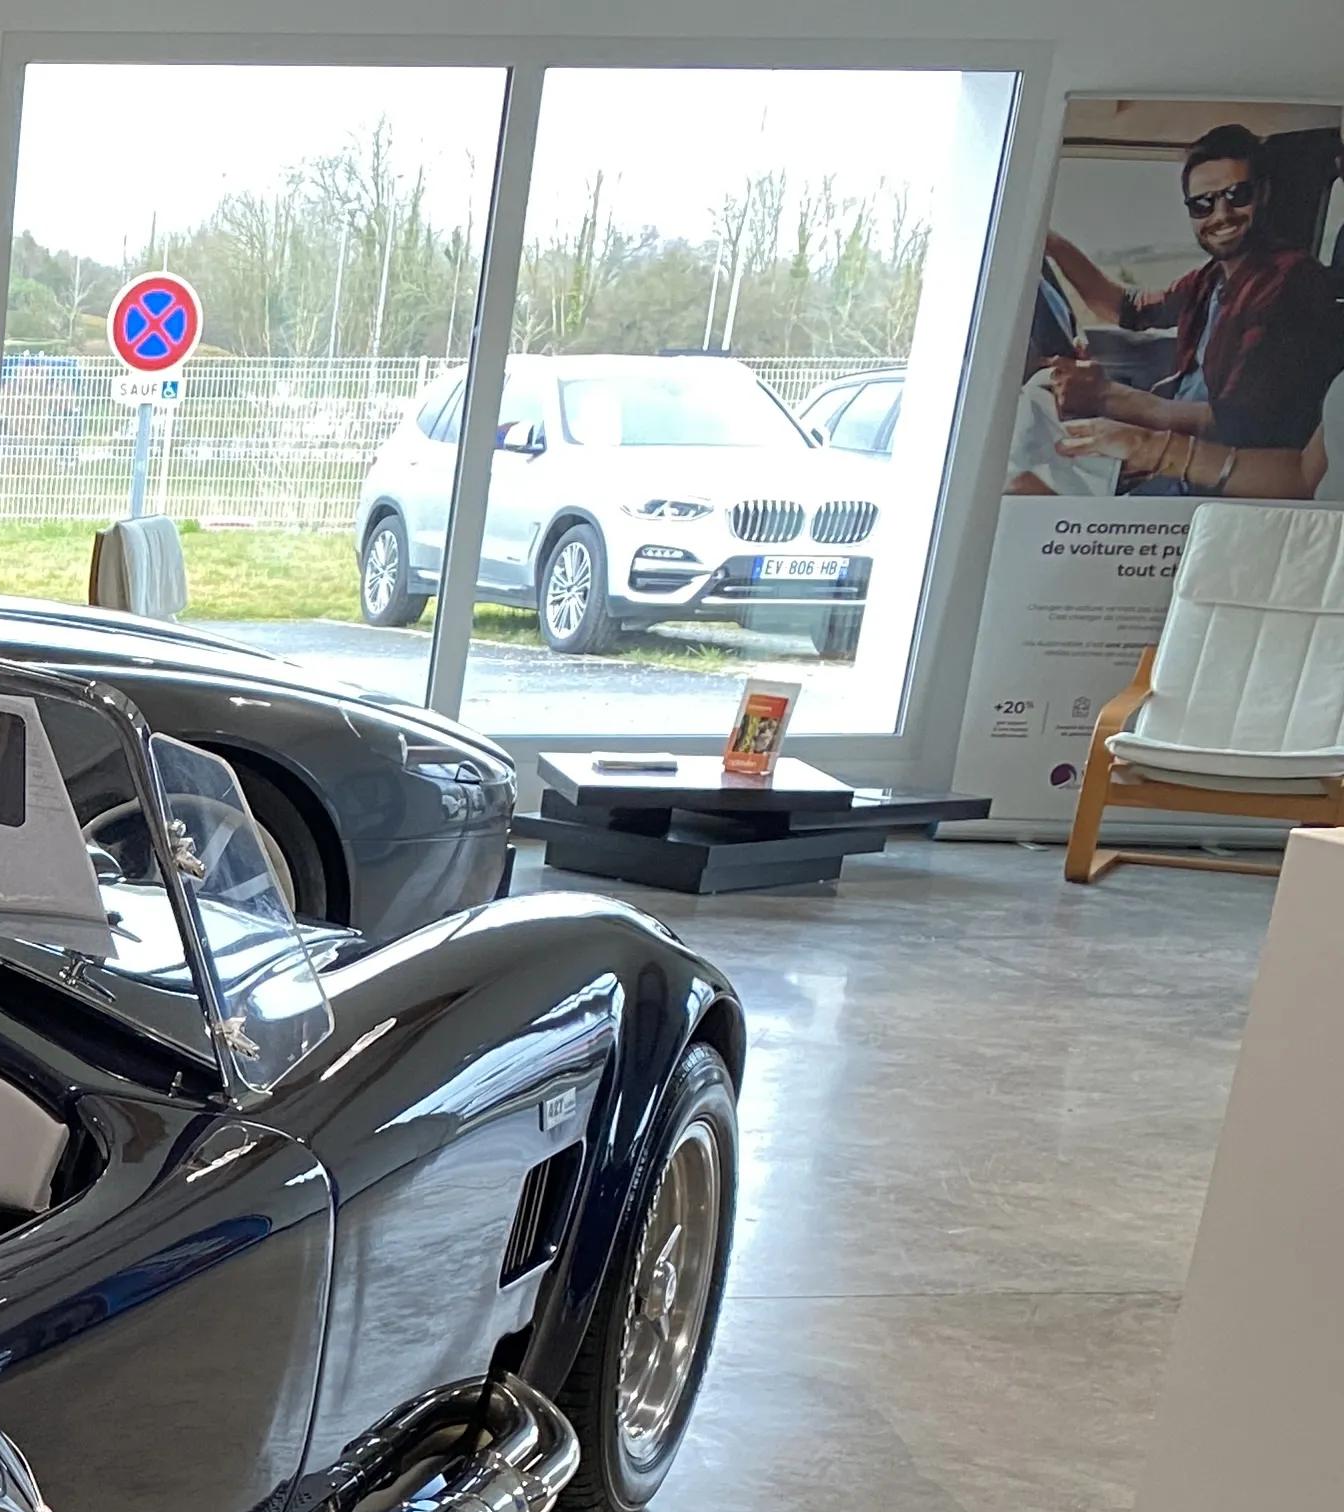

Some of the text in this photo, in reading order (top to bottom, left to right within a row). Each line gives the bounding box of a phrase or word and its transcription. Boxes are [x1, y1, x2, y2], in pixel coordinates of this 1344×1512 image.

[120, 383, 158, 396] SAUF
[1055, 520, 1081, 534] On
[1041, 541, 1064, 555] de
[1070, 541, 1134, 556] voiture
[1139, 544, 1159, 556] et
[764, 560, 837, 575] EV 806 HB
[1117, 564, 1155, 577] tout
